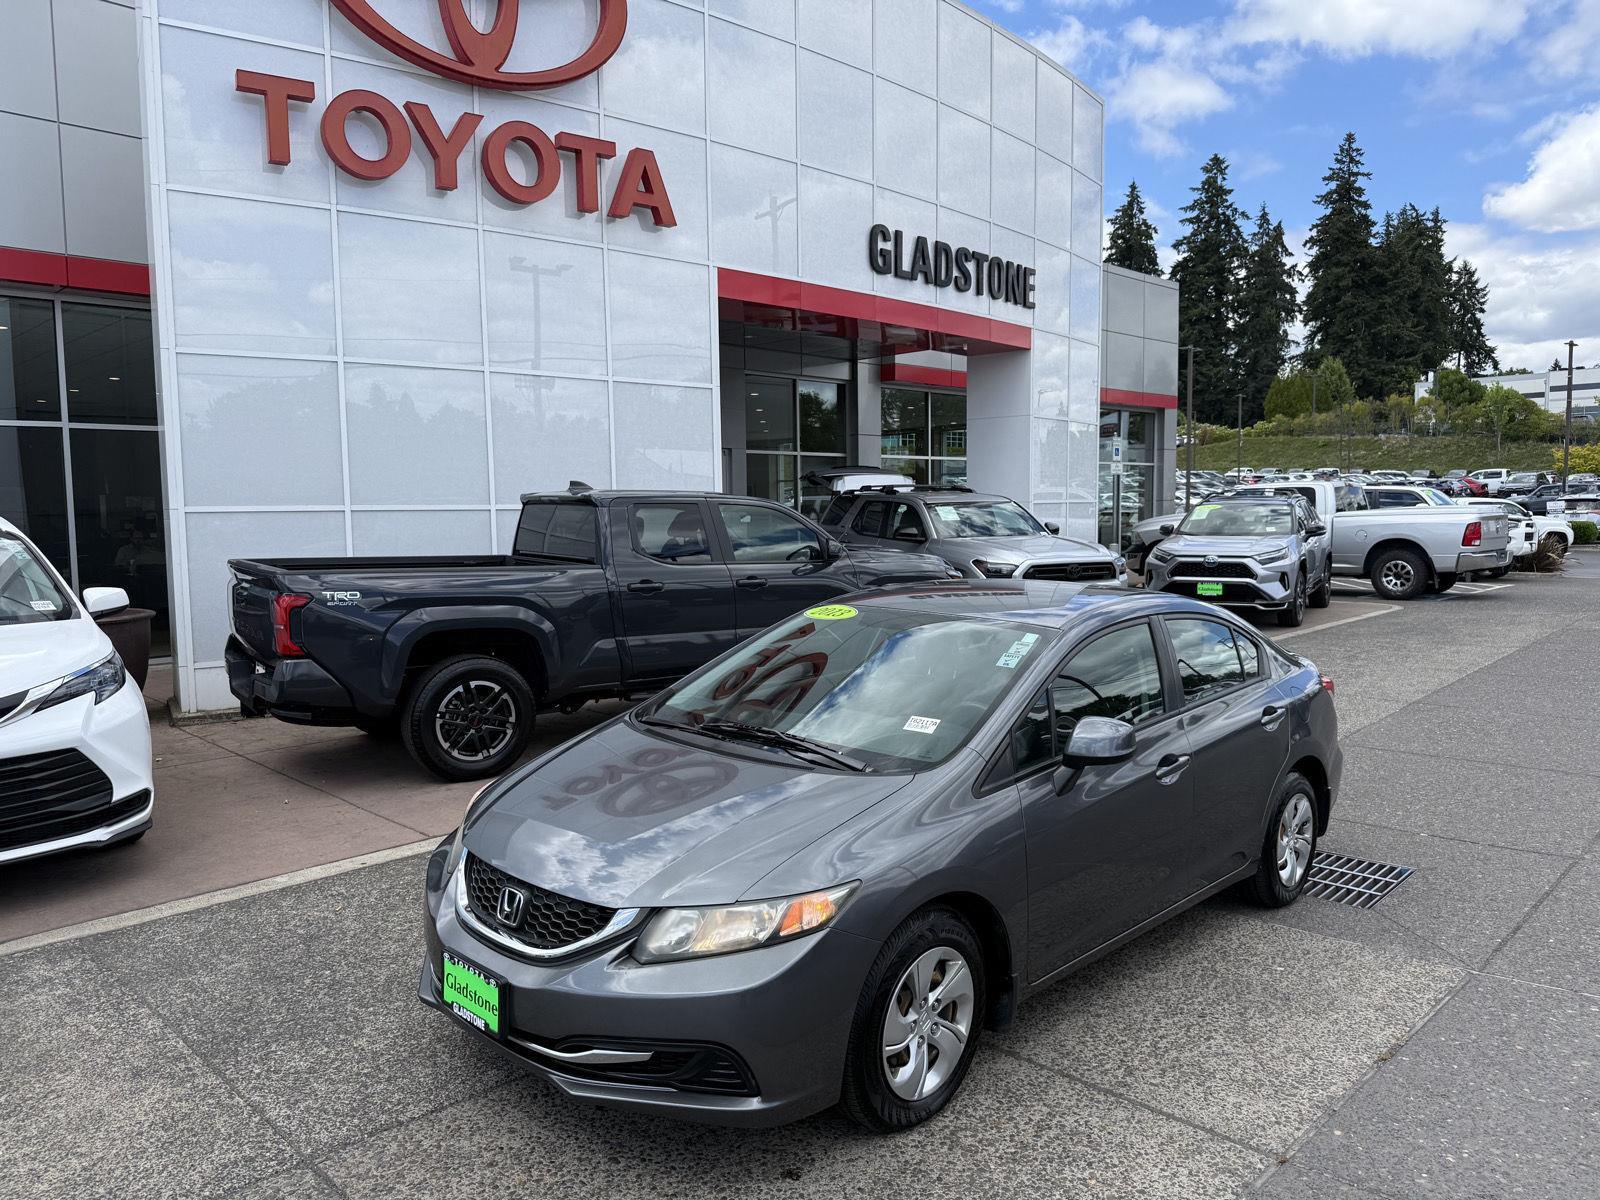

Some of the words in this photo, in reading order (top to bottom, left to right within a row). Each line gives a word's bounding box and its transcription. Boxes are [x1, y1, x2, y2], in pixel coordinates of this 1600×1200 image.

[235, 68, 677, 229] TOYOTA
[868, 223, 1036, 309] GLADSTONE
[321, 591, 361, 601] TRD
[453, 957, 486, 981] TOYOTA
[446, 972, 498, 1017] Gladstone
[452, 1002, 486, 1031] GLADSTONE
